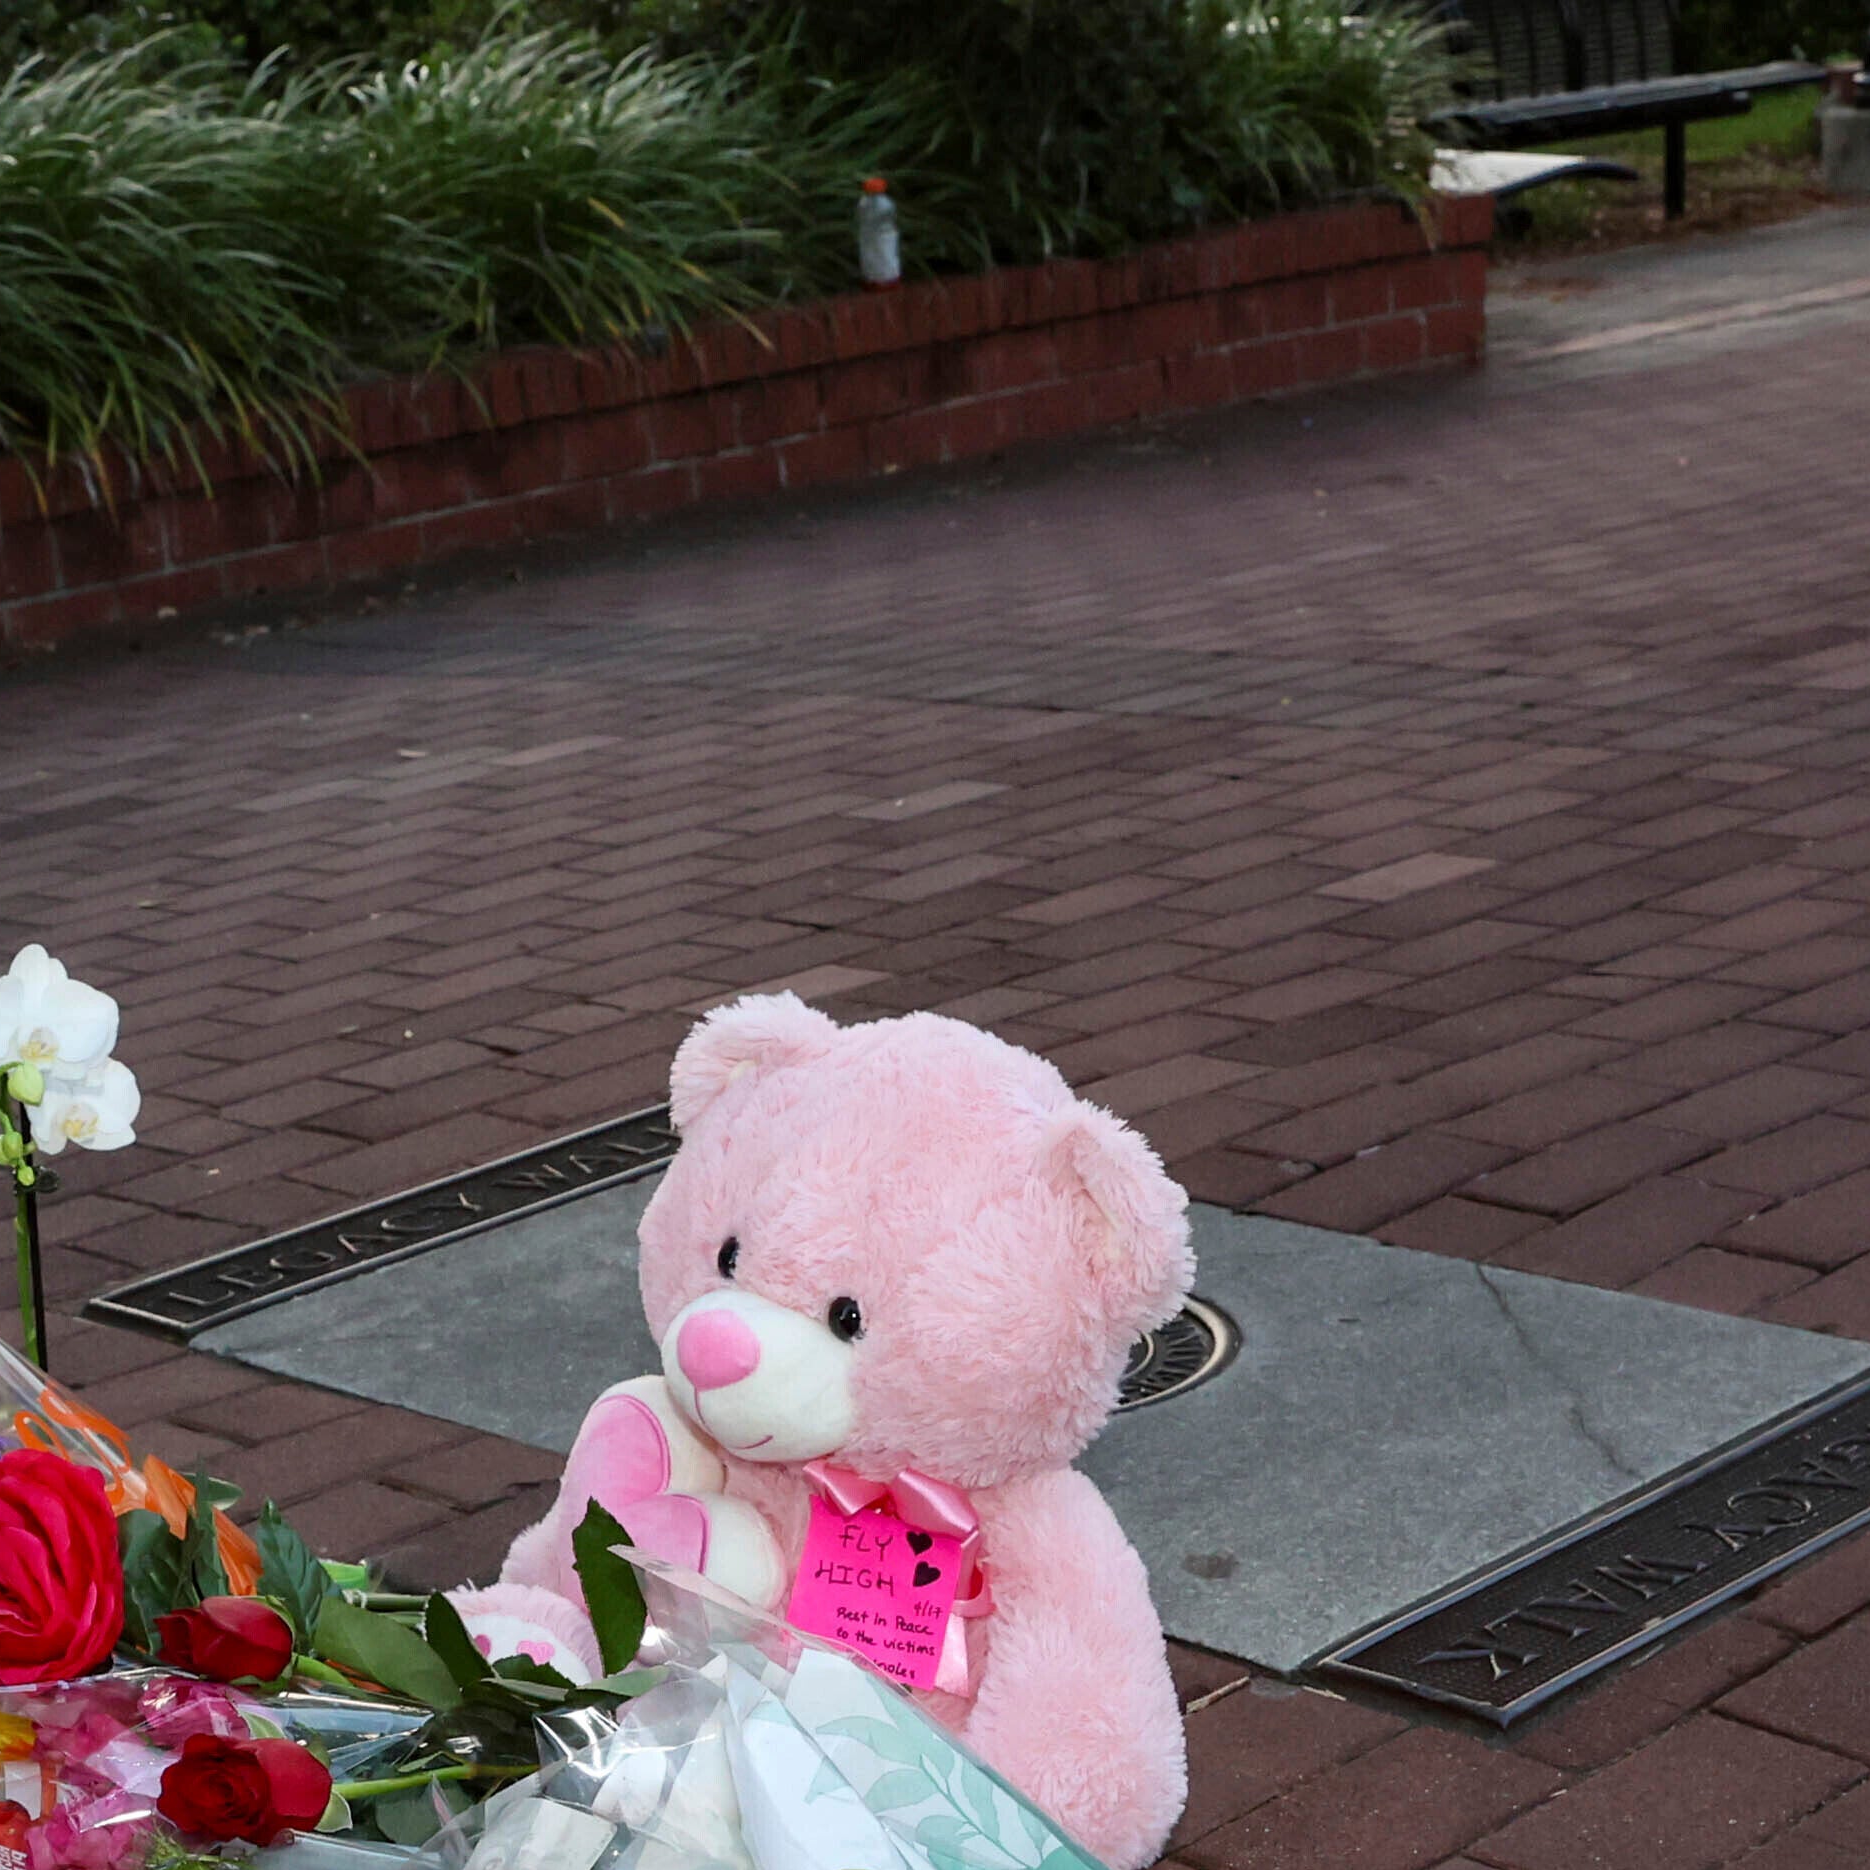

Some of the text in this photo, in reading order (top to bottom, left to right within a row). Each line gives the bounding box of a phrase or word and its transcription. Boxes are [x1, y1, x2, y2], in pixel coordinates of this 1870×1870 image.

[167, 1191, 482, 1307] LEGACY
[839, 1524, 893, 1561] FLY
[815, 1560, 894, 1597] HIGH
[837, 1607, 869, 1623] Rest
[874, 1613, 887, 1626] in
[1416, 1553, 1708, 1681] WALK
[837, 1627, 935, 1656] to the victims
